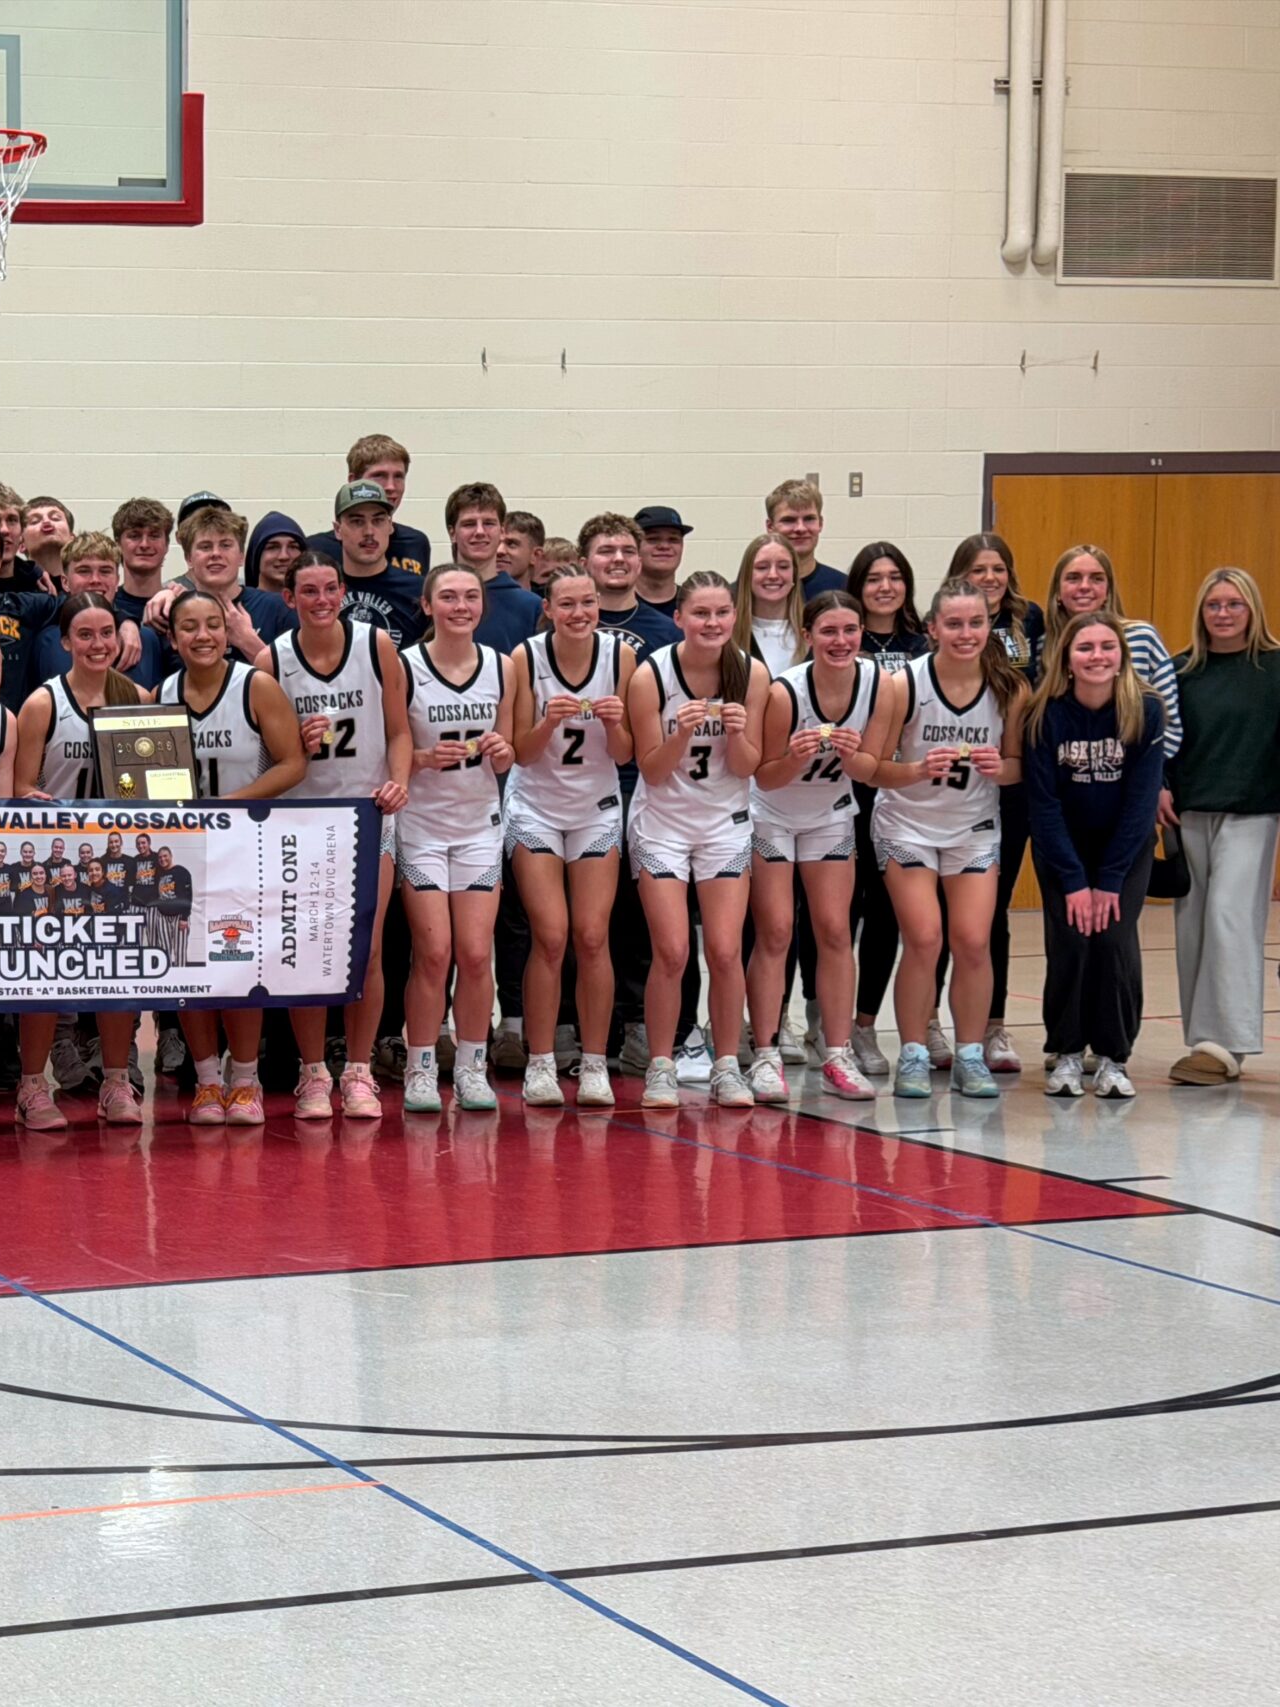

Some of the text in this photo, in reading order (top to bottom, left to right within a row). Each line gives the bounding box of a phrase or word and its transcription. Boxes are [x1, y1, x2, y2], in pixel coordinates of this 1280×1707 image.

[358, 591, 393, 615] VALLEY
[874, 652, 906, 661] STATE
[295, 690, 364, 714] COSSACKS
[428, 703, 493, 723] COSSACKS
[121, 718, 161, 727] STATE
[668, 717, 728, 737] CSACK
[922, 724, 989, 744] COSSACKS
[192, 730, 232, 749] SACKS
[562, 728, 585, 765] 2
[1058, 737, 1124, 765] BASKETBA
[689, 746, 712, 781] 3
[801, 757, 843, 782] 14
[97, 811, 232, 831] COSSACKS
[281, 834, 298, 969] ADMIT ONE
[309, 861, 320, 942] MARCH 12-14
[323, 824, 337, 977] WATERTOWN CIVIC ARENA
[57, 986, 129, 995] BASKETBALL
[132, 985, 212, 994] TOURNAMENT
